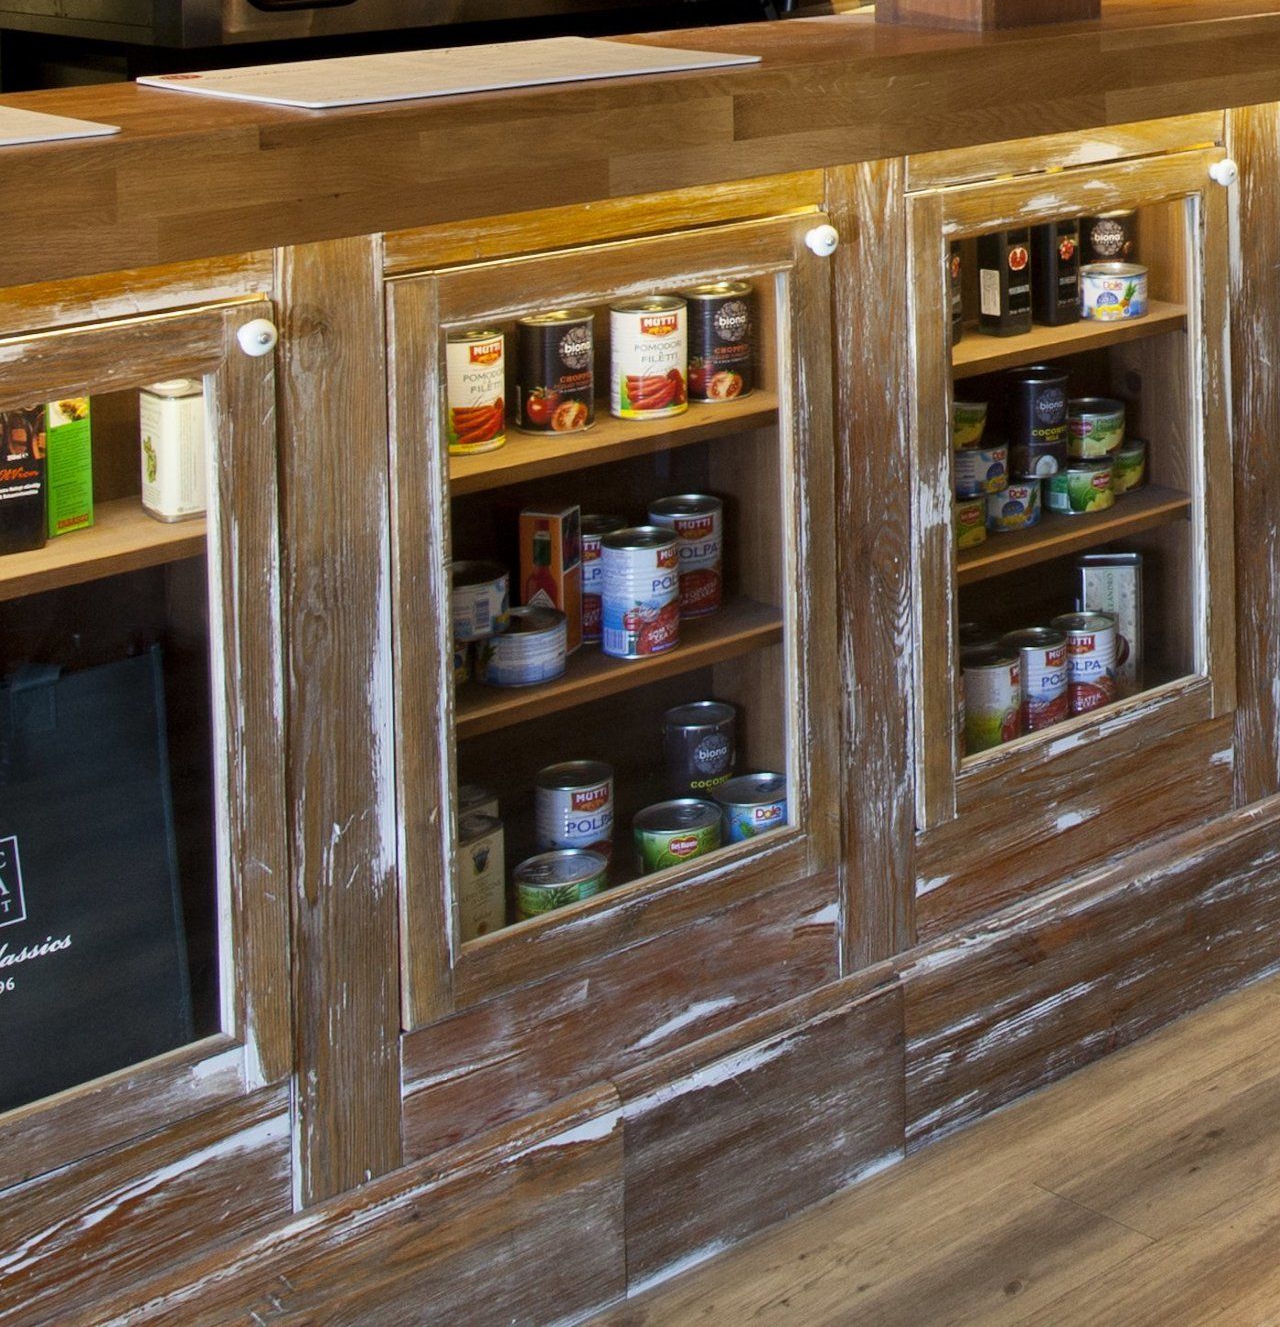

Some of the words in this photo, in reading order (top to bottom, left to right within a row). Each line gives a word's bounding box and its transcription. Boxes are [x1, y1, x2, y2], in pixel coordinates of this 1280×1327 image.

[643, 316, 675, 327] MUTTI
[719, 315, 746, 326] biona
[678, 517, 711, 529] MUTTI
[699, 746, 727, 760] biona
[576, 788, 607, 803] MUTTI
[755, 805, 782, 819] Dole
